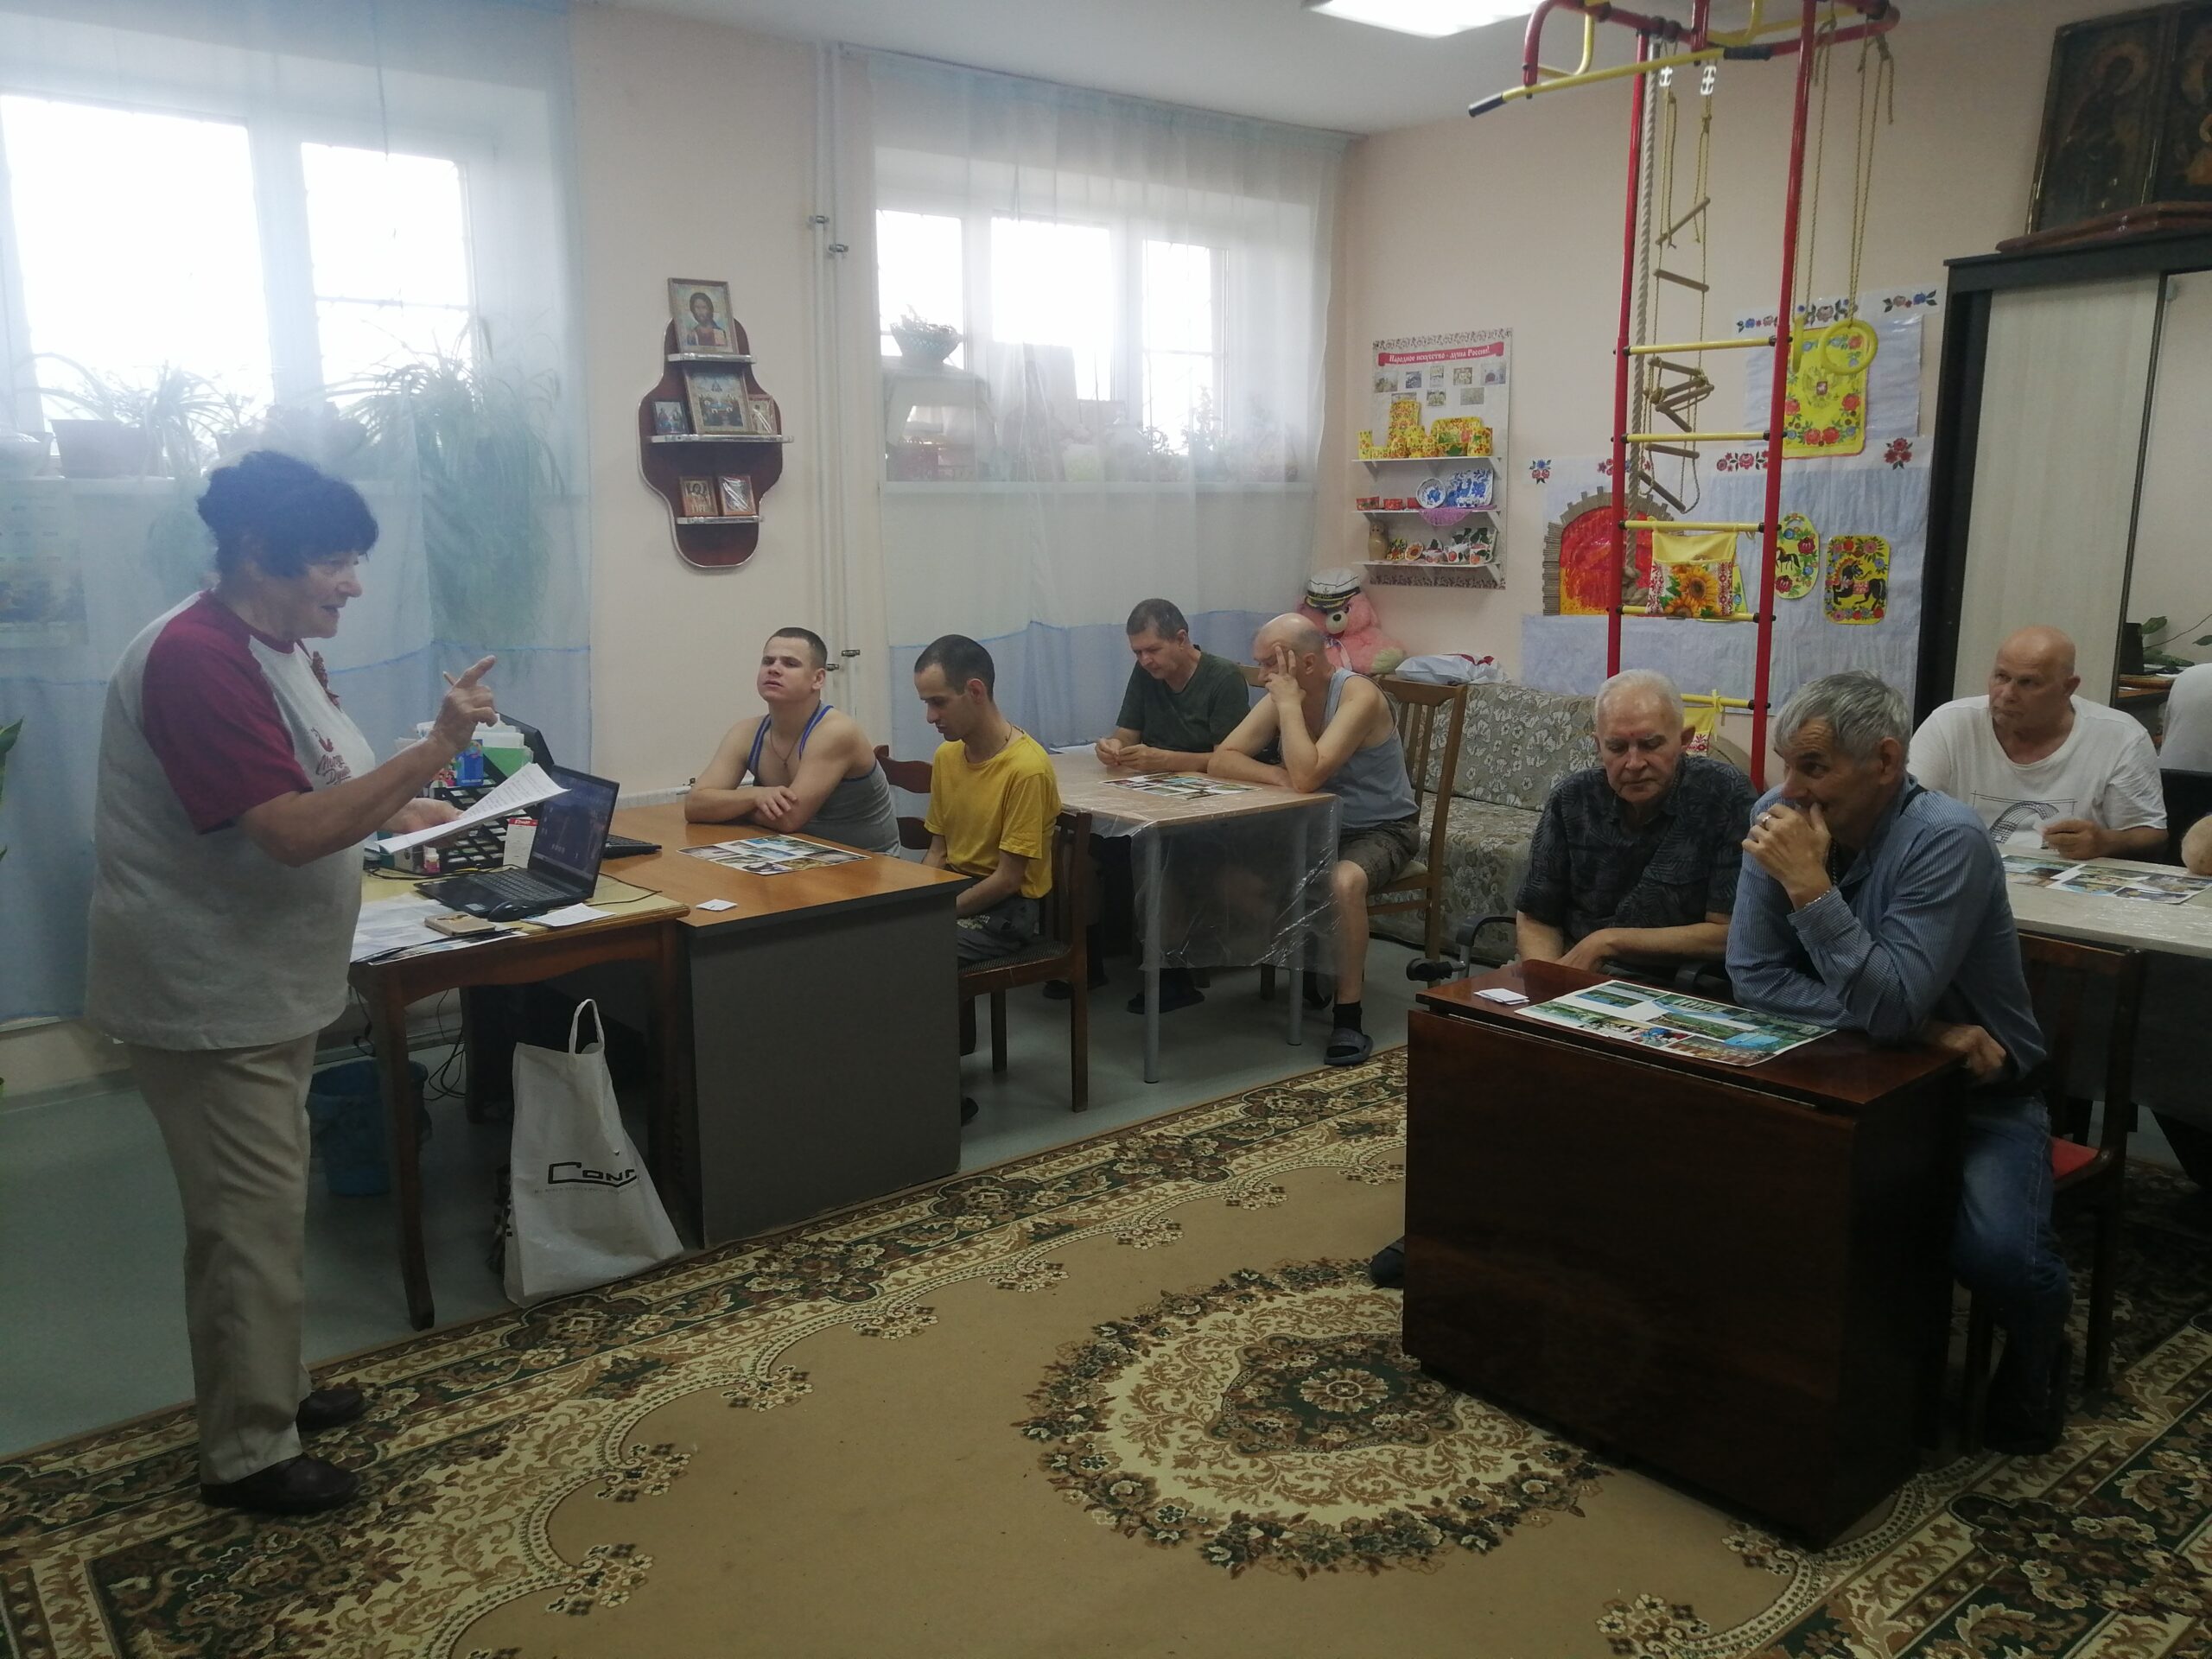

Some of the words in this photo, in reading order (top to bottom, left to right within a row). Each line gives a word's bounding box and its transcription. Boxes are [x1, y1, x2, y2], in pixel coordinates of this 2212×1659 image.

[1389, 355, 1415, 365] Народное
[1416, 353, 1445, 362] искусство
[1450, 351, 1465, 359] душа
[1468, 346, 1491, 357] России!
